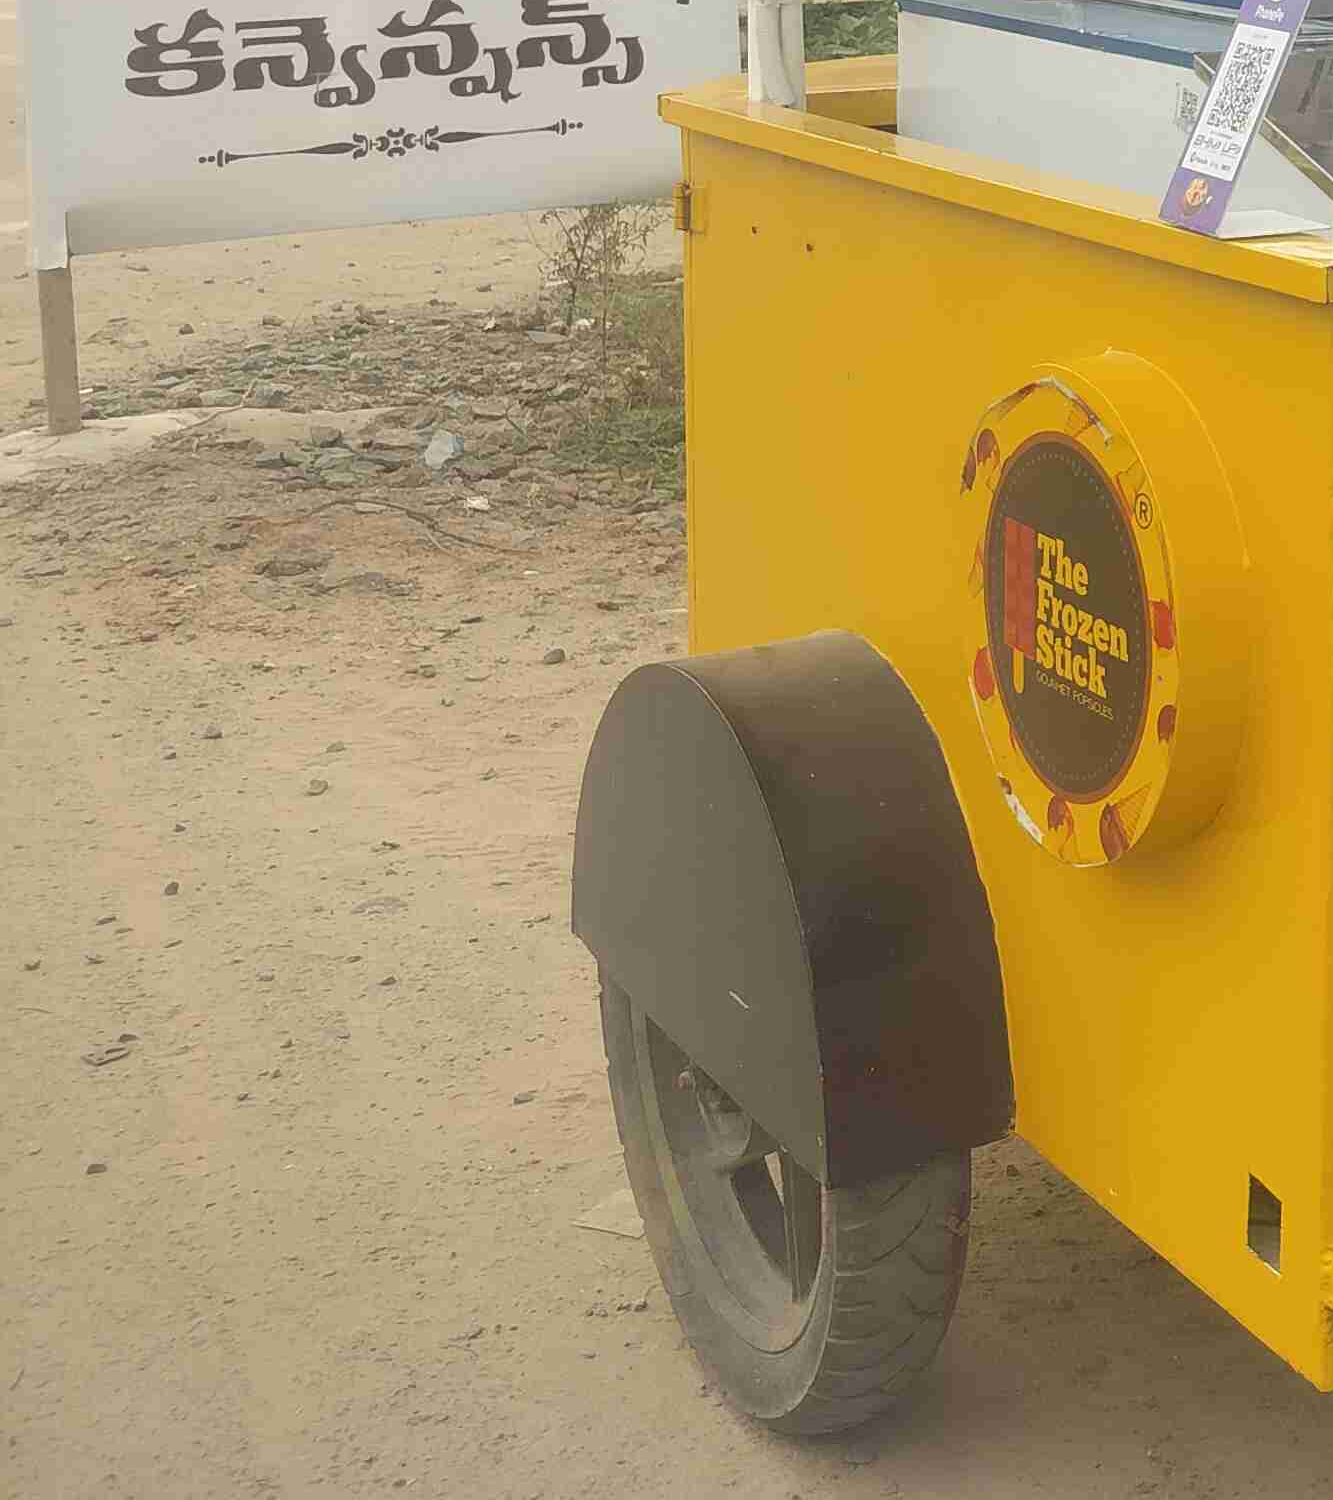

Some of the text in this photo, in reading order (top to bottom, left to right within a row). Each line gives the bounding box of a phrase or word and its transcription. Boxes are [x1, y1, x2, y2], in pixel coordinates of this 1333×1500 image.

[1037, 532, 1089, 596] The
[1036, 578, 1128, 662] Frozen
[1036, 624, 1107, 699] Stick
